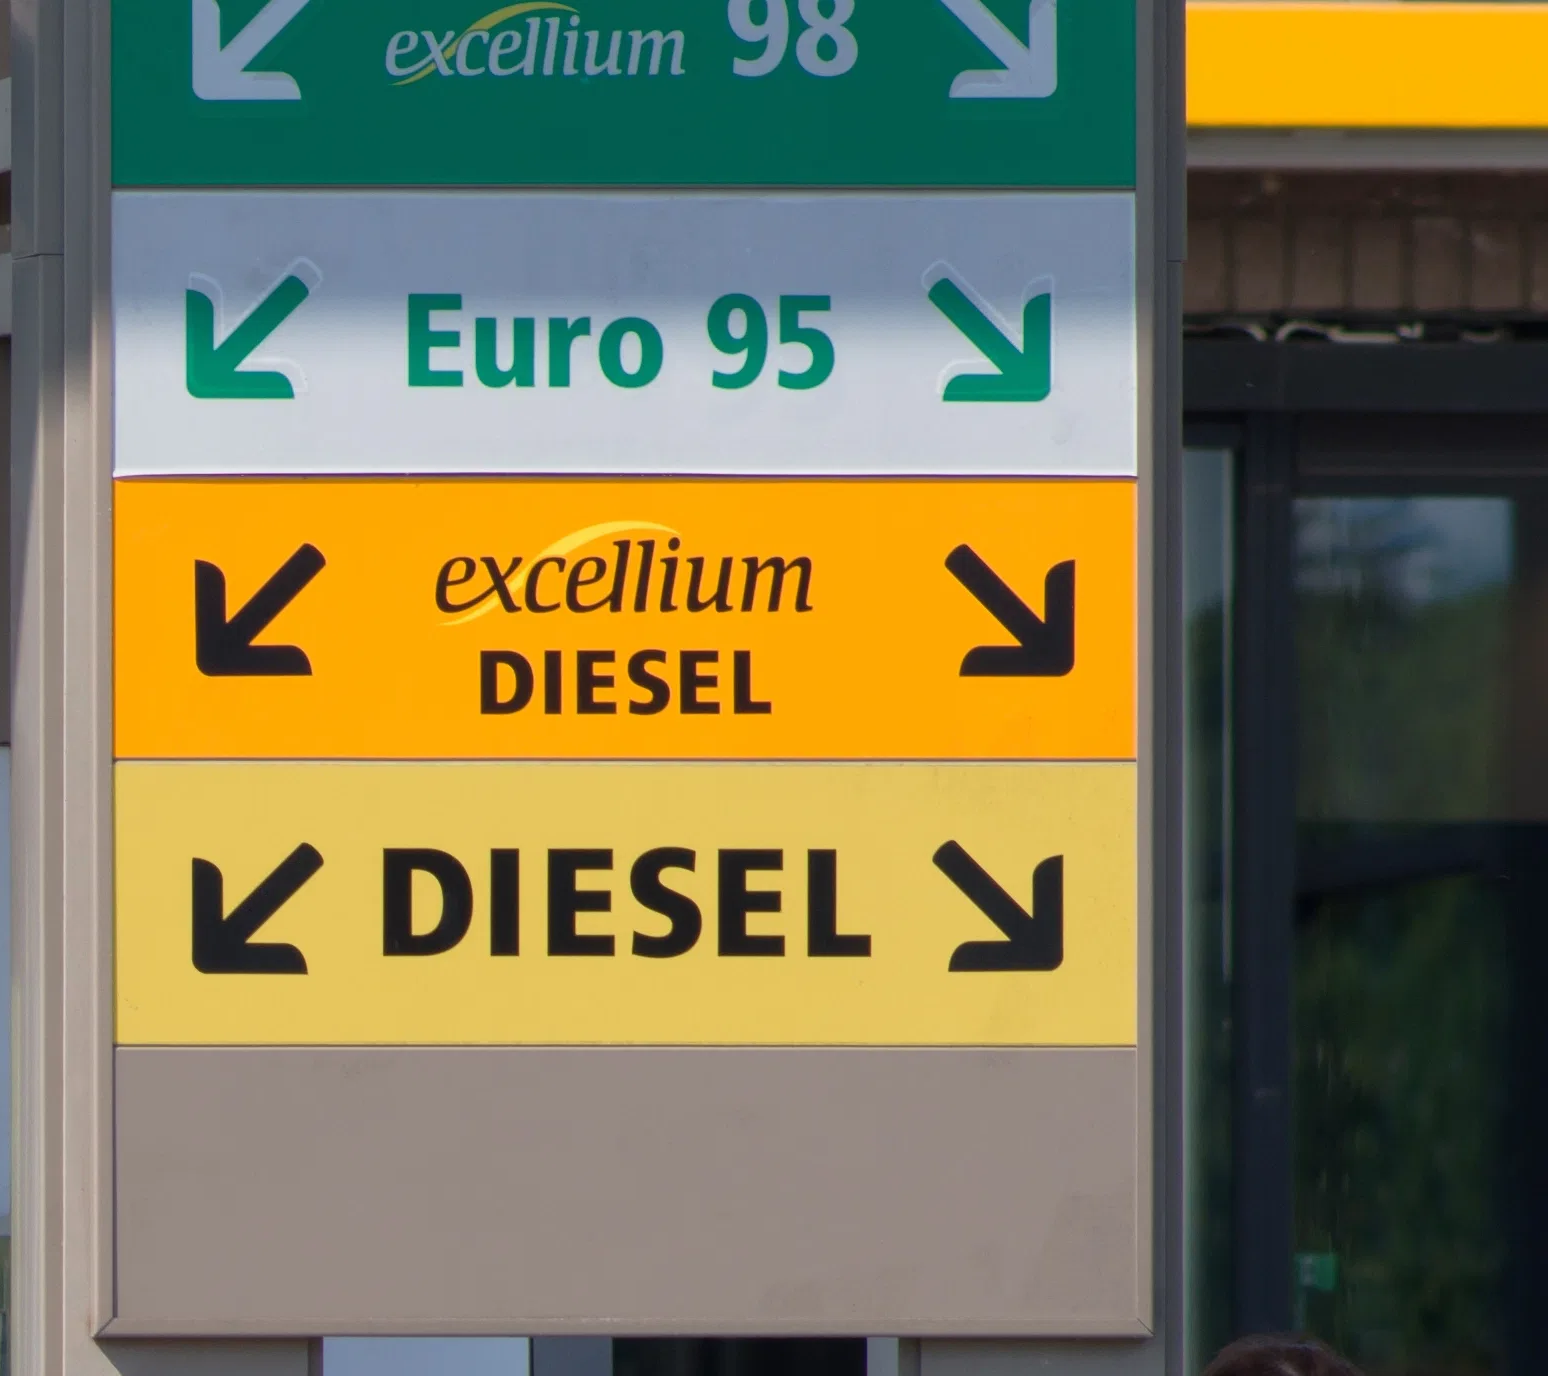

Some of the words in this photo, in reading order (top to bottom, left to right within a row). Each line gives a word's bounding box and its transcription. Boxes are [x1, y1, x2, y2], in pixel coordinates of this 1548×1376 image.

[385, 14, 685, 77] excellium
[727, 0, 859, 77] 98
[406, 292, 664, 390] Euro
[706, 292, 836, 391] 95
[435, 537, 812, 614] excellium
[479, 649, 772, 715] DIESEL
[382, 846, 872, 959] DIESEL
